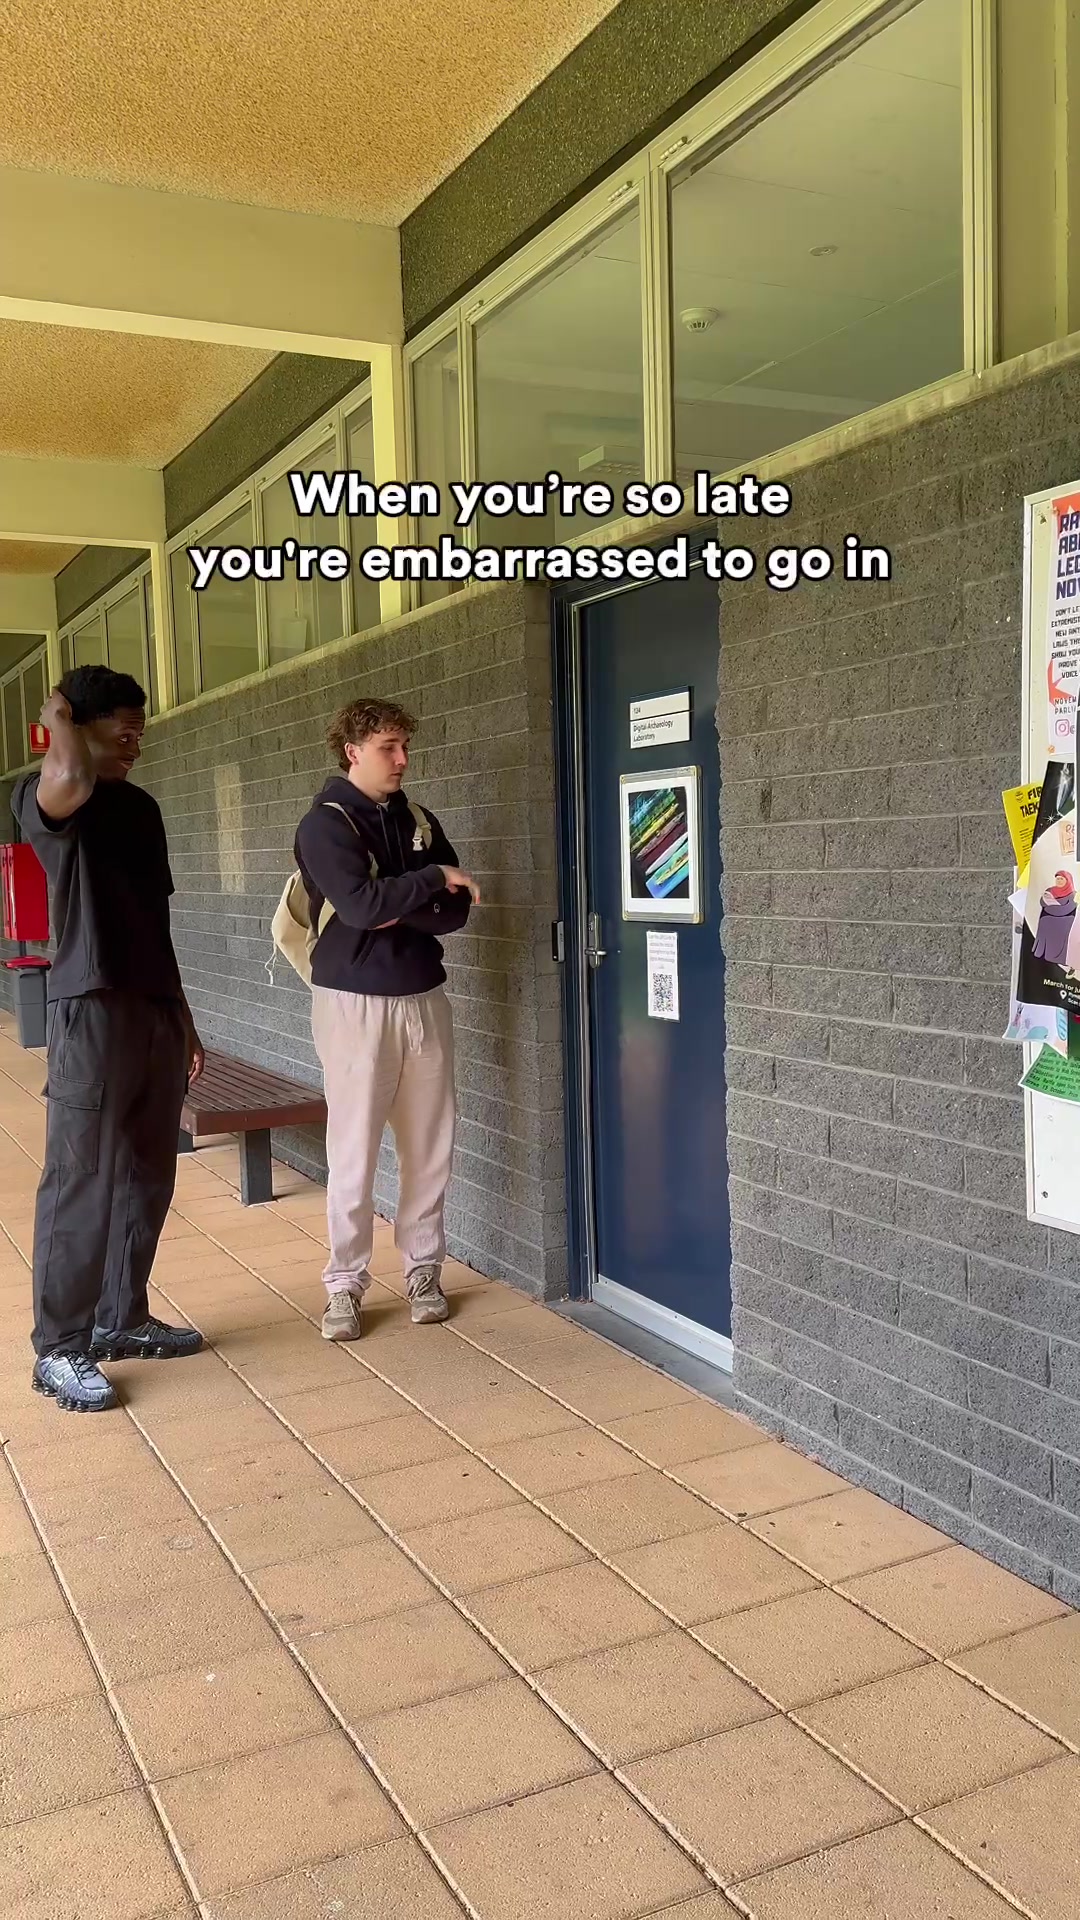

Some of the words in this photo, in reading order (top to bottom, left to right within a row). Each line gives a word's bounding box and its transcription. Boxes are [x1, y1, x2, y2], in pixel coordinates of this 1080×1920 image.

[1058, 533, 1080, 555] AB
[1056, 578, 1080, 600] NO
[633, 733, 655, 742] Laboratory
[1043, 979, 1064, 989] March
